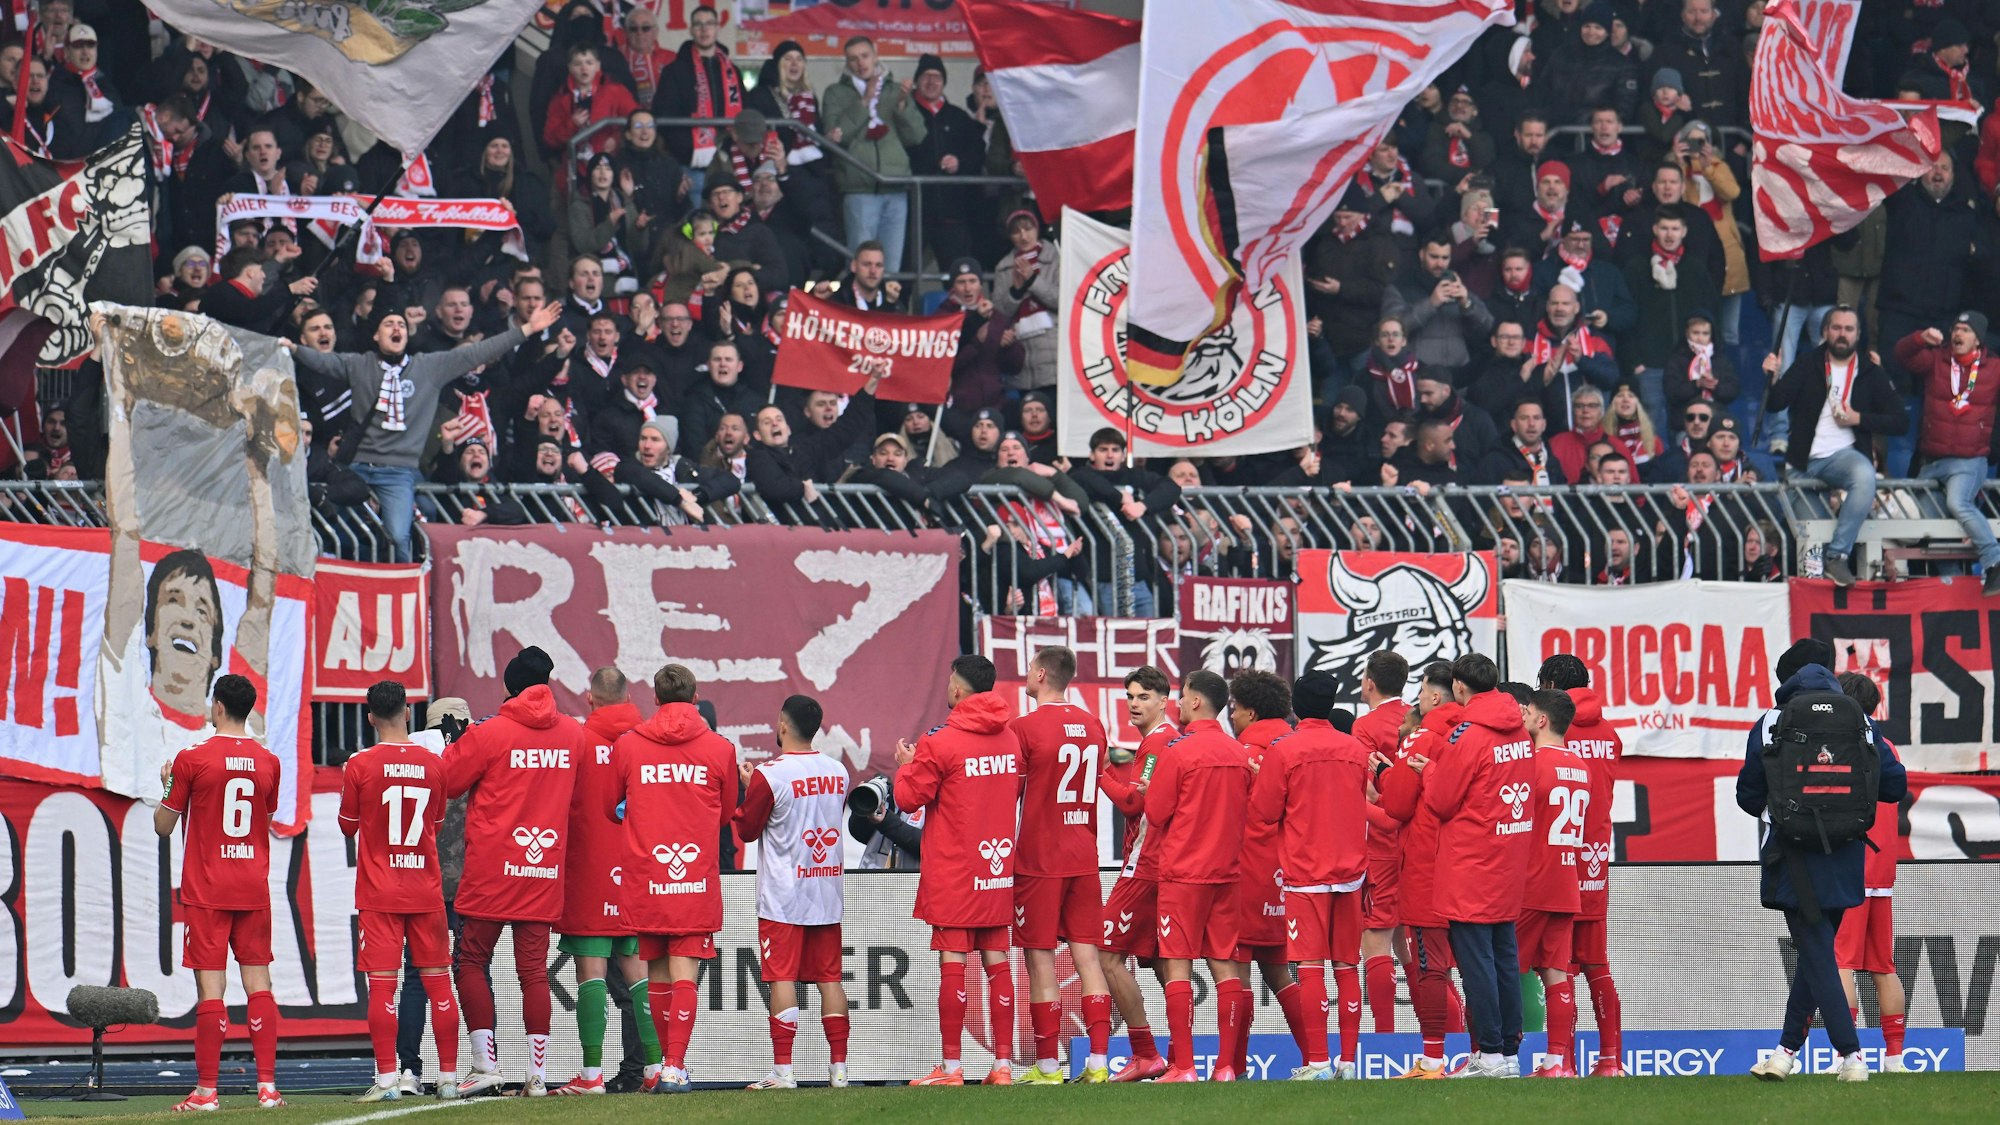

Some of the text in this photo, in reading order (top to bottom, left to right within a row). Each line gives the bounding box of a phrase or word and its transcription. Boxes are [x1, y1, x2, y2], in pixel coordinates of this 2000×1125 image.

[786, 309, 961, 359] HÖHER JUNGS
[847, 354, 893, 378] 203
[1182, 350, 1288, 443] KÖLN
[1193, 584, 1288, 624] RAFIKIS
[323, 591, 418, 673] AJJ
[1811, 703, 1832, 712] evoc
[1063, 724, 1087, 737] TIGGES
[1639, 710, 1685, 731] KÖLN
[510, 749, 571, 769] REWE
[1493, 740, 1533, 764] REWE
[1567, 740, 1615, 760] REWE
[225, 757, 256, 772] MARTEL
[383, 763, 425, 779] PACARADA
[640, 763, 708, 785] REWE
[964, 754, 1017, 778] REWE
[1057, 743, 1099, 804] 21
[1142, 756, 1155, 780] DEVK
[1555, 767, 1588, 783] THIELMANN
[791, 776, 845, 799] REWE
[222, 777, 255, 838] 6
[382, 785, 432, 847] 17
[1548, 786, 1590, 848] 29
[1496, 817, 1533, 836] hummel
[504, 861, 559, 879] hummel
[797, 862, 842, 879] hummel
[649, 878, 707, 895] hummel
